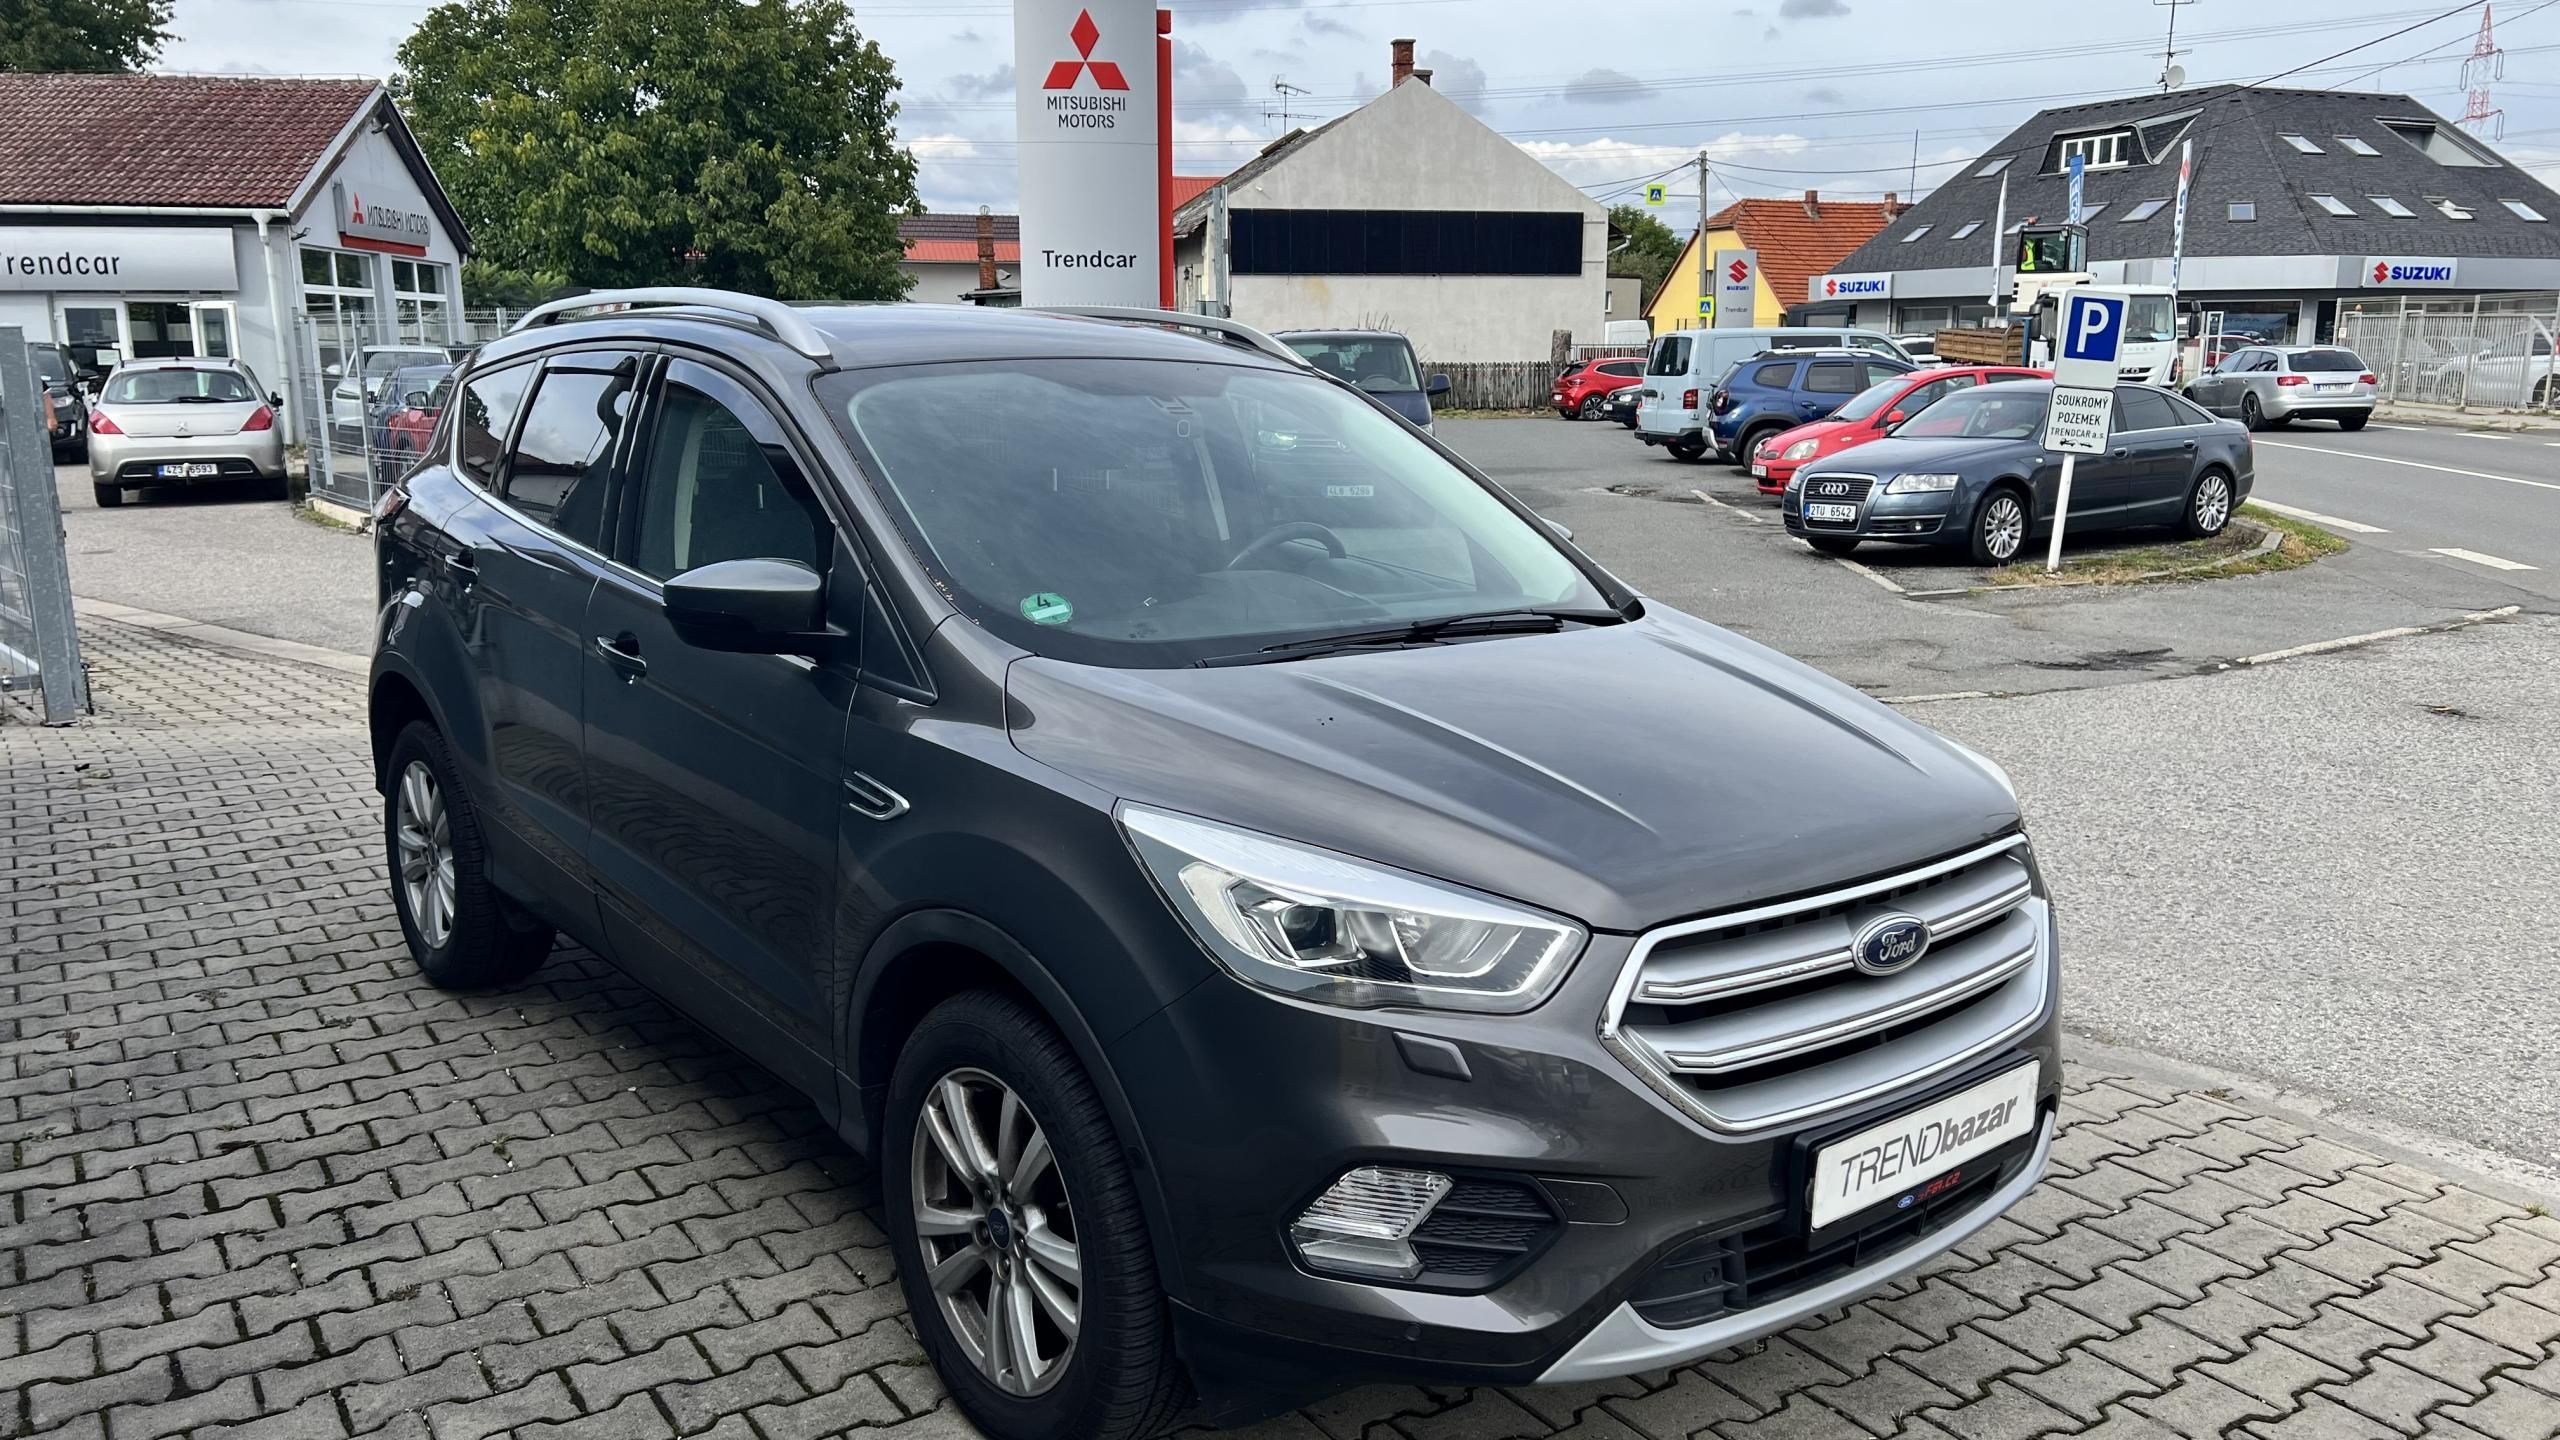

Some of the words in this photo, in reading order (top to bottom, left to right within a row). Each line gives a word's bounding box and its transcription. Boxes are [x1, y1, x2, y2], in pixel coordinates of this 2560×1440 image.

[1047, 96, 1126, 111] MITSUBISHI
[1058, 114, 1115, 128] MOTORS
[367, 205, 404, 231] MITSUBISHI
[404, 211, 429, 235] MOTORS
[0, 252, 120, 275] rendcar
[1042, 250, 1137, 268] Trendcar
[2391, 266, 2451, 280] SUZUKI
[1839, 280, 1885, 293] SUZUKI
[2076, 301, 2110, 353] P
[2056, 394, 2109, 409] SOUKROMÝ
[2057, 411, 2101, 426] POZEMEK
[2050, 427, 2091, 438] TRENDCAR
[1810, 504, 1826, 517] 2TU
[1830, 505, 1852, 518] 6542
[1880, 928, 1916, 961] Ford
[1841, 1095, 2018, 1198] TRENDbazar
